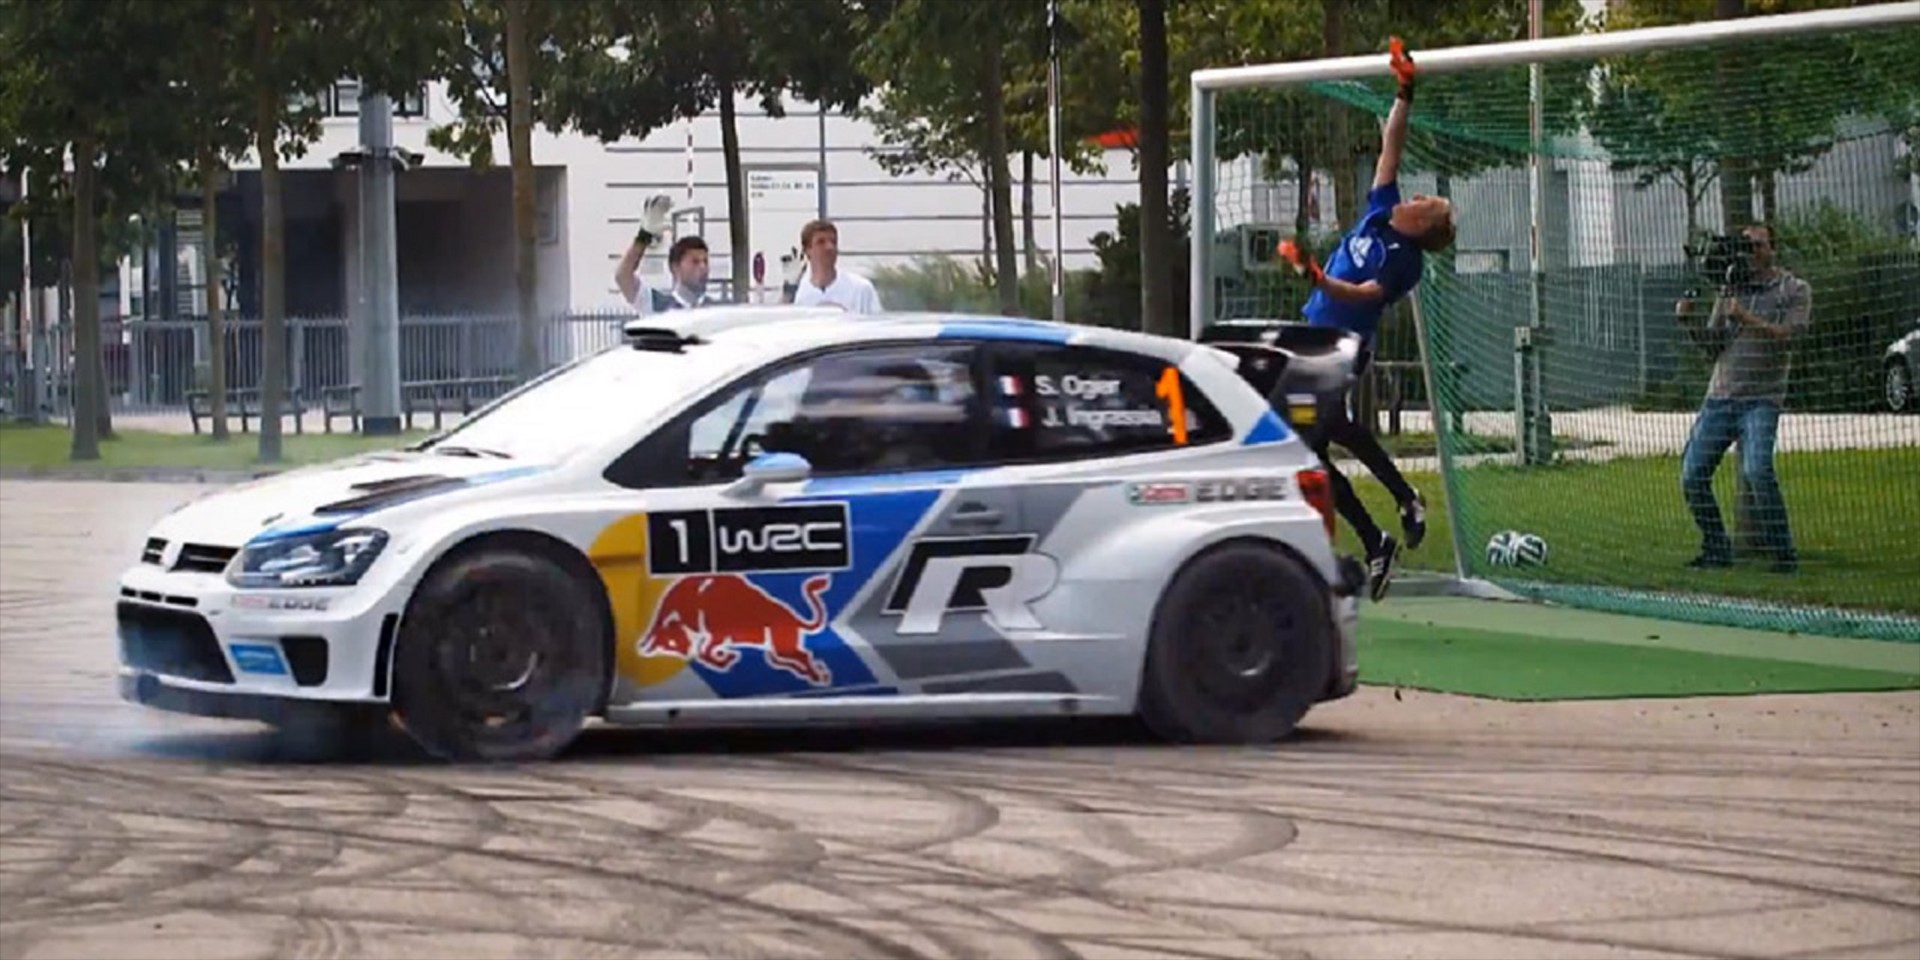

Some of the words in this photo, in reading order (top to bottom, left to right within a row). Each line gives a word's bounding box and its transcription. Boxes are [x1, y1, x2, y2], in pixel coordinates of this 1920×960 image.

[1155, 367, 1188, 444] 1
[1196, 477, 1288, 503] EDGE
[668, 520, 689, 564] 1
[720, 522, 842, 554] WRC
[893, 550, 1060, 634] R
